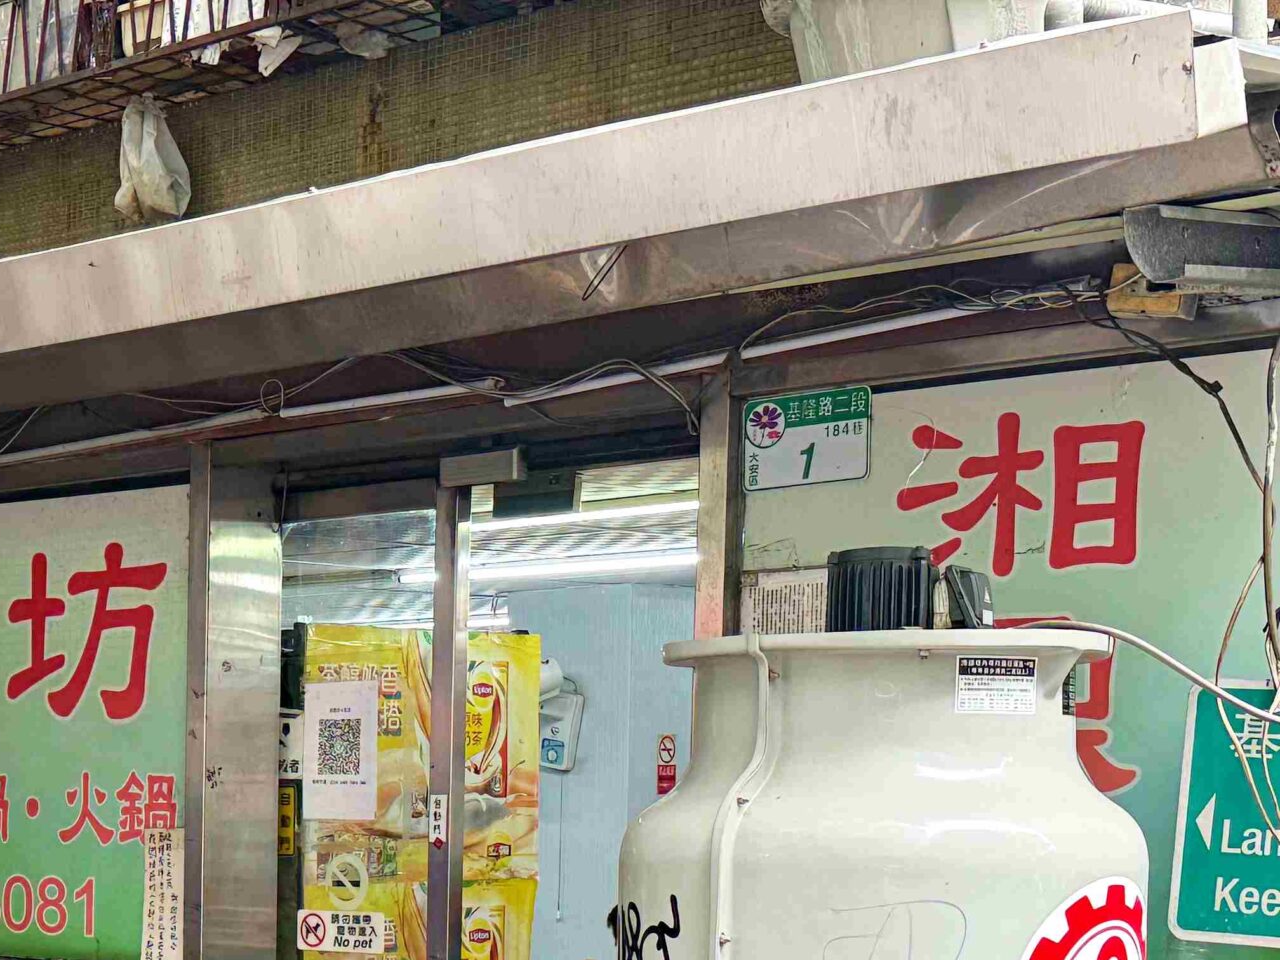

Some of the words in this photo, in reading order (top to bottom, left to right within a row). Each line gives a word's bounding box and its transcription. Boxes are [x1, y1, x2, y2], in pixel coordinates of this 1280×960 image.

[786, 391, 867, 422] 基隆路二段
[748, 452, 760, 487] 大安區
[799, 442, 816, 480] 1
[333, 935, 350, 948] No
[353, 937, 373, 950] pet
[470, 931, 490, 941] Lipton
